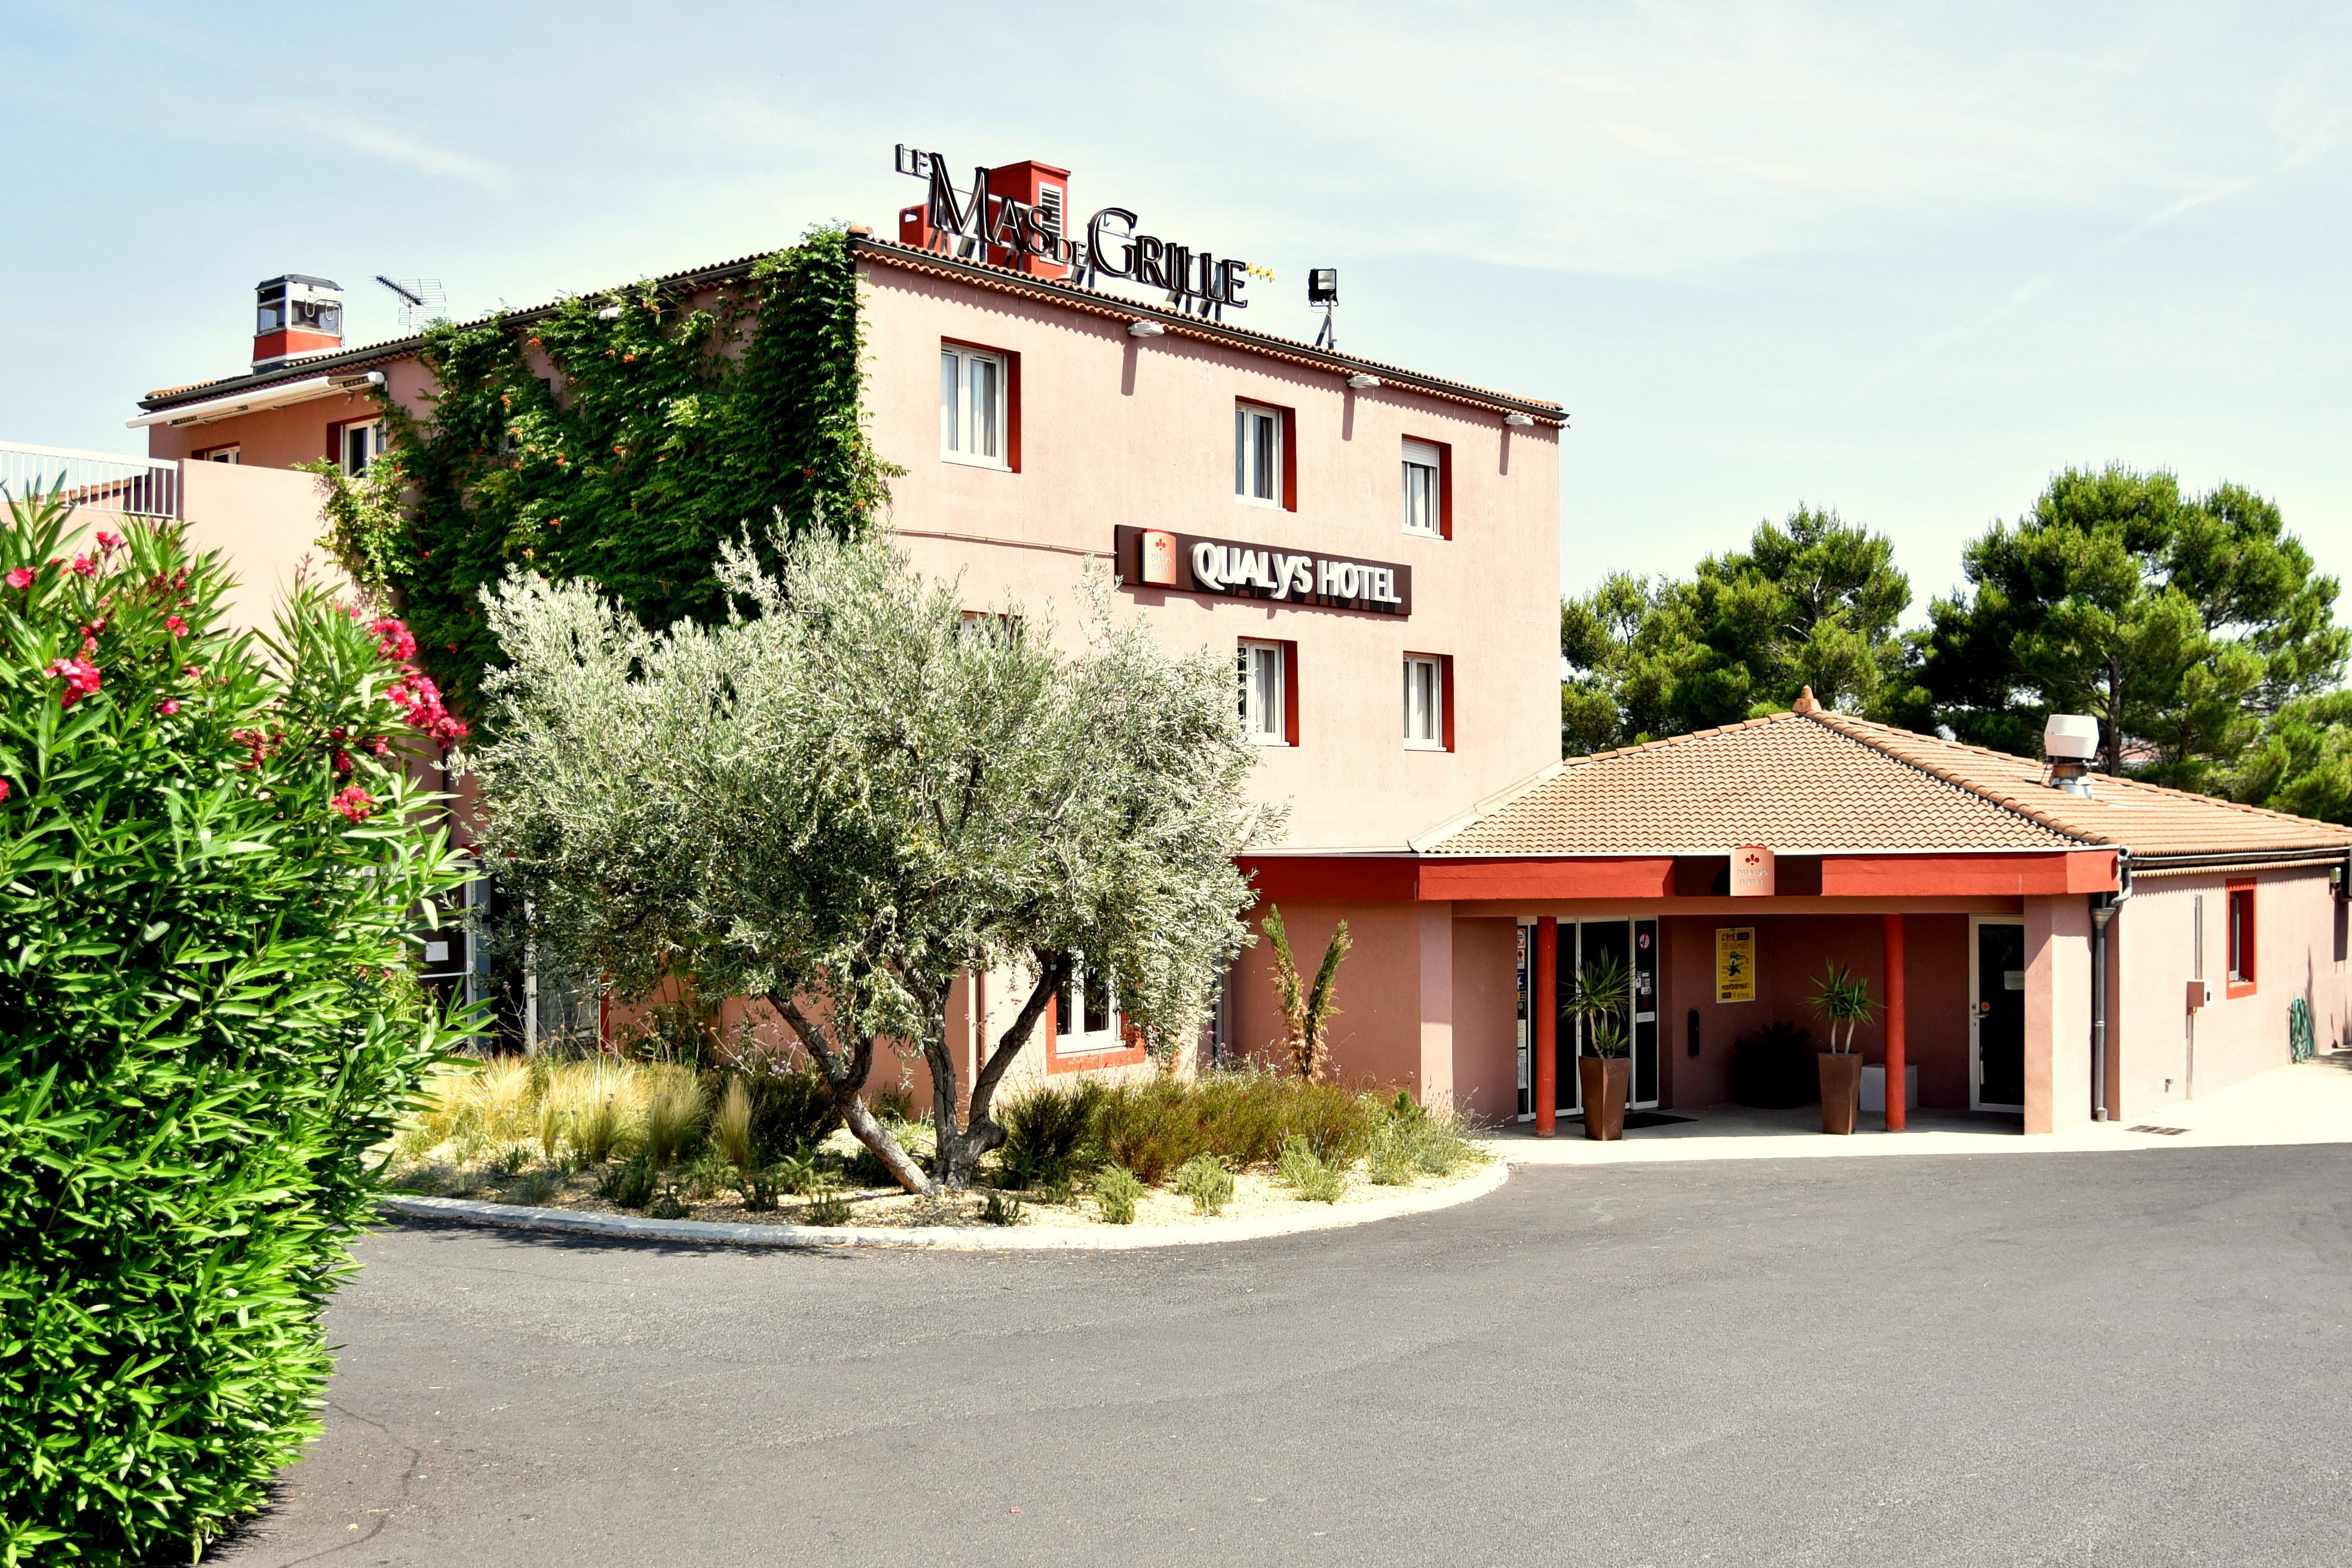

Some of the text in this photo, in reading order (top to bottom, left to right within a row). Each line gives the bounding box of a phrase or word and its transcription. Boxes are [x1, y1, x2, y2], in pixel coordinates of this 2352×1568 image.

[895, 144, 1248, 308] LE MAS DE GRILLE
[1193, 542, 1402, 604] QUALYS HOTEL
